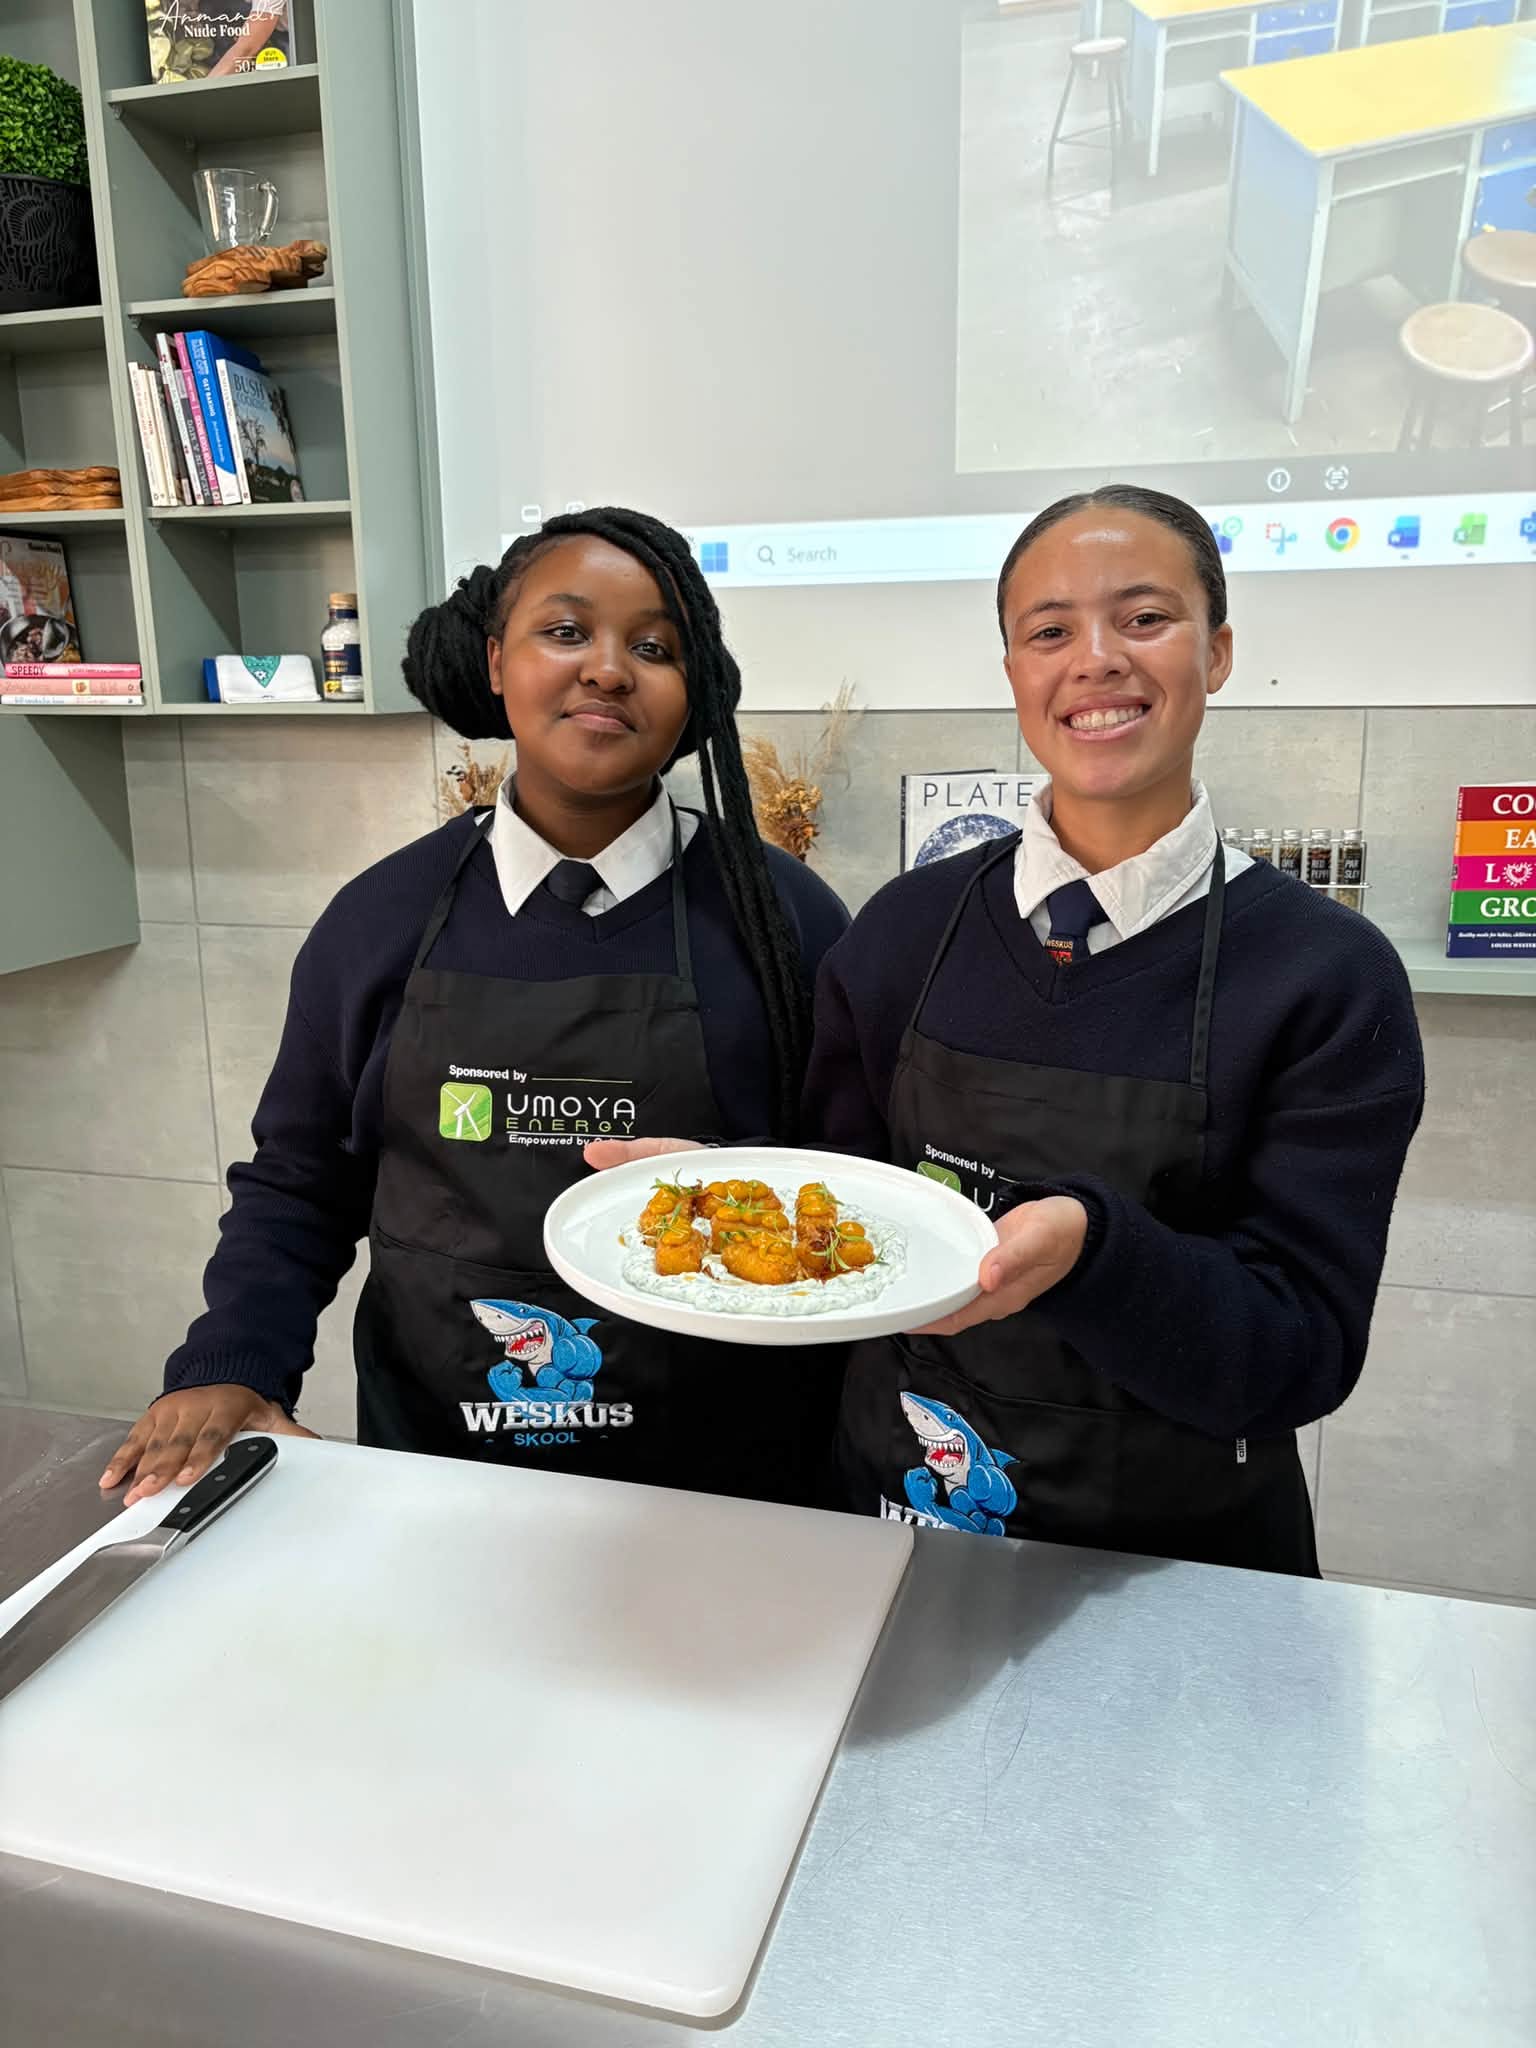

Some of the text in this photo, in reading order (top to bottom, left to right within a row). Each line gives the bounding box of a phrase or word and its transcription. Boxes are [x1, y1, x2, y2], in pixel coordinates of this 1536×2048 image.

[184, 22, 251, 38] Nude Food
[202, 377, 210, 392] GET
[233, 374, 265, 401] BUSH
[787, 546, 838, 564] Search
[11, 665, 45, 676] SPEEDY
[1492, 793, 1536, 815] CO
[449, 1065, 527, 1083] Sponsored by
[506, 1093, 636, 1120] UMOYA
[506, 1117, 635, 1134] ENERGY
[509, 1134, 573, 1146] Empowered
[925, 1144, 995, 1179] Sponsored by
[459, 1402, 634, 1432] WESKUS
[514, 1432, 581, 1447] SKOOL
